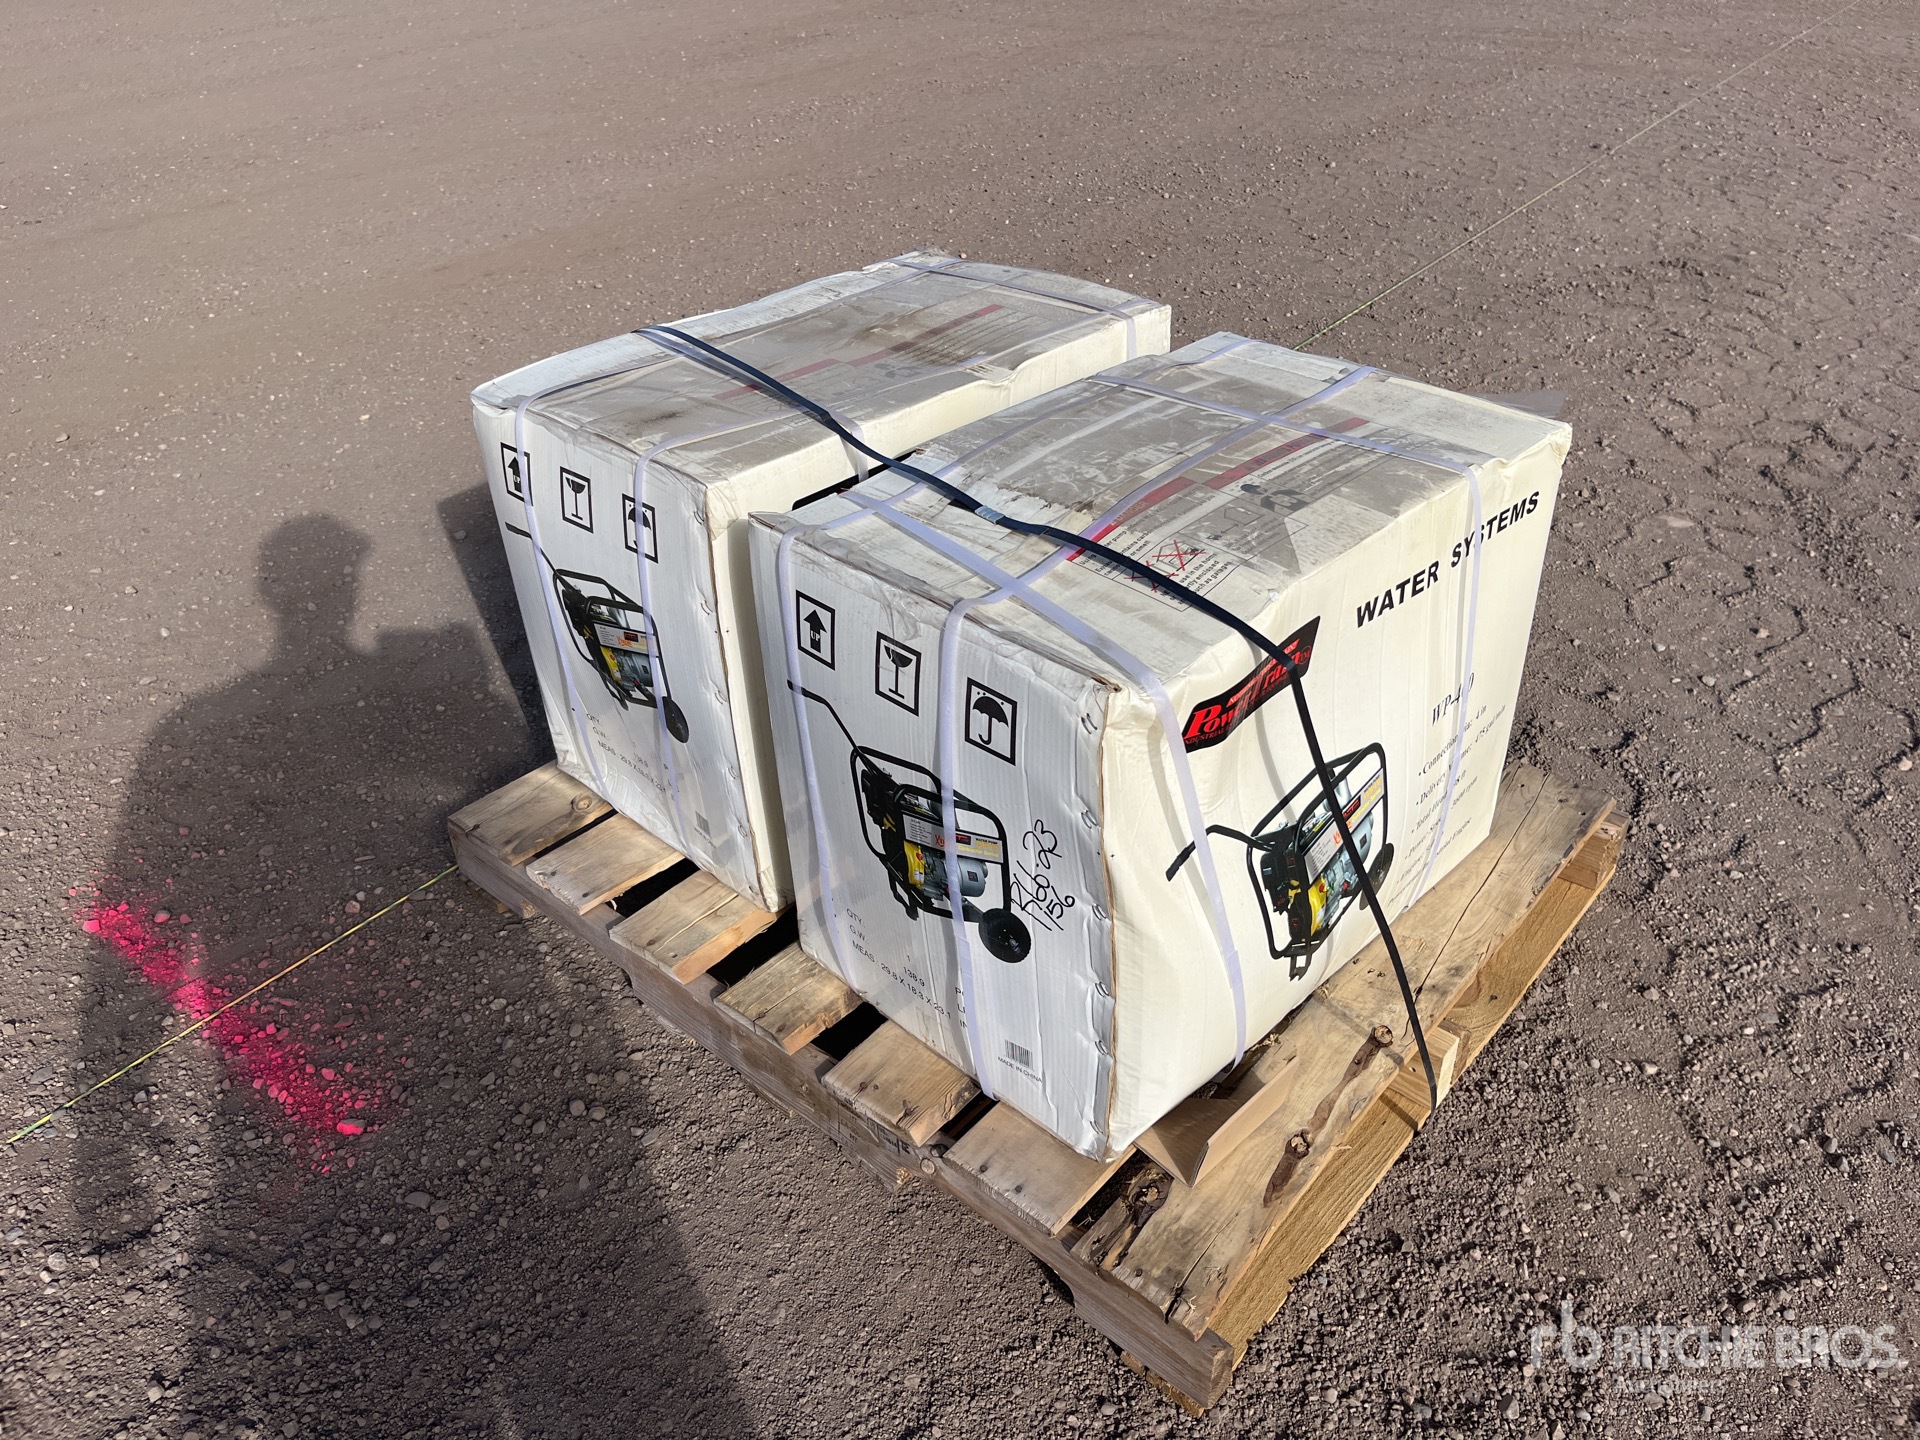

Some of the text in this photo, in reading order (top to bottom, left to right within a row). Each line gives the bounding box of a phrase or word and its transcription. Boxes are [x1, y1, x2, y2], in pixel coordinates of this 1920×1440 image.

[1179, 574, 1190, 583] use
[1195, 560, 1219, 580] enclosed
[1356, 560, 1440, 628] WATER
[811, 630, 821, 642] UP
[903, 966, 925, 987] 138.9
[880, 962, 898, 980] 29.8
[907, 983, 924, 1000] 18.3
[933, 1002, 951, 1019] 23.1
[998, 1056, 1015, 1069] MADE
[1022, 1069, 1043, 1083] CHINA
